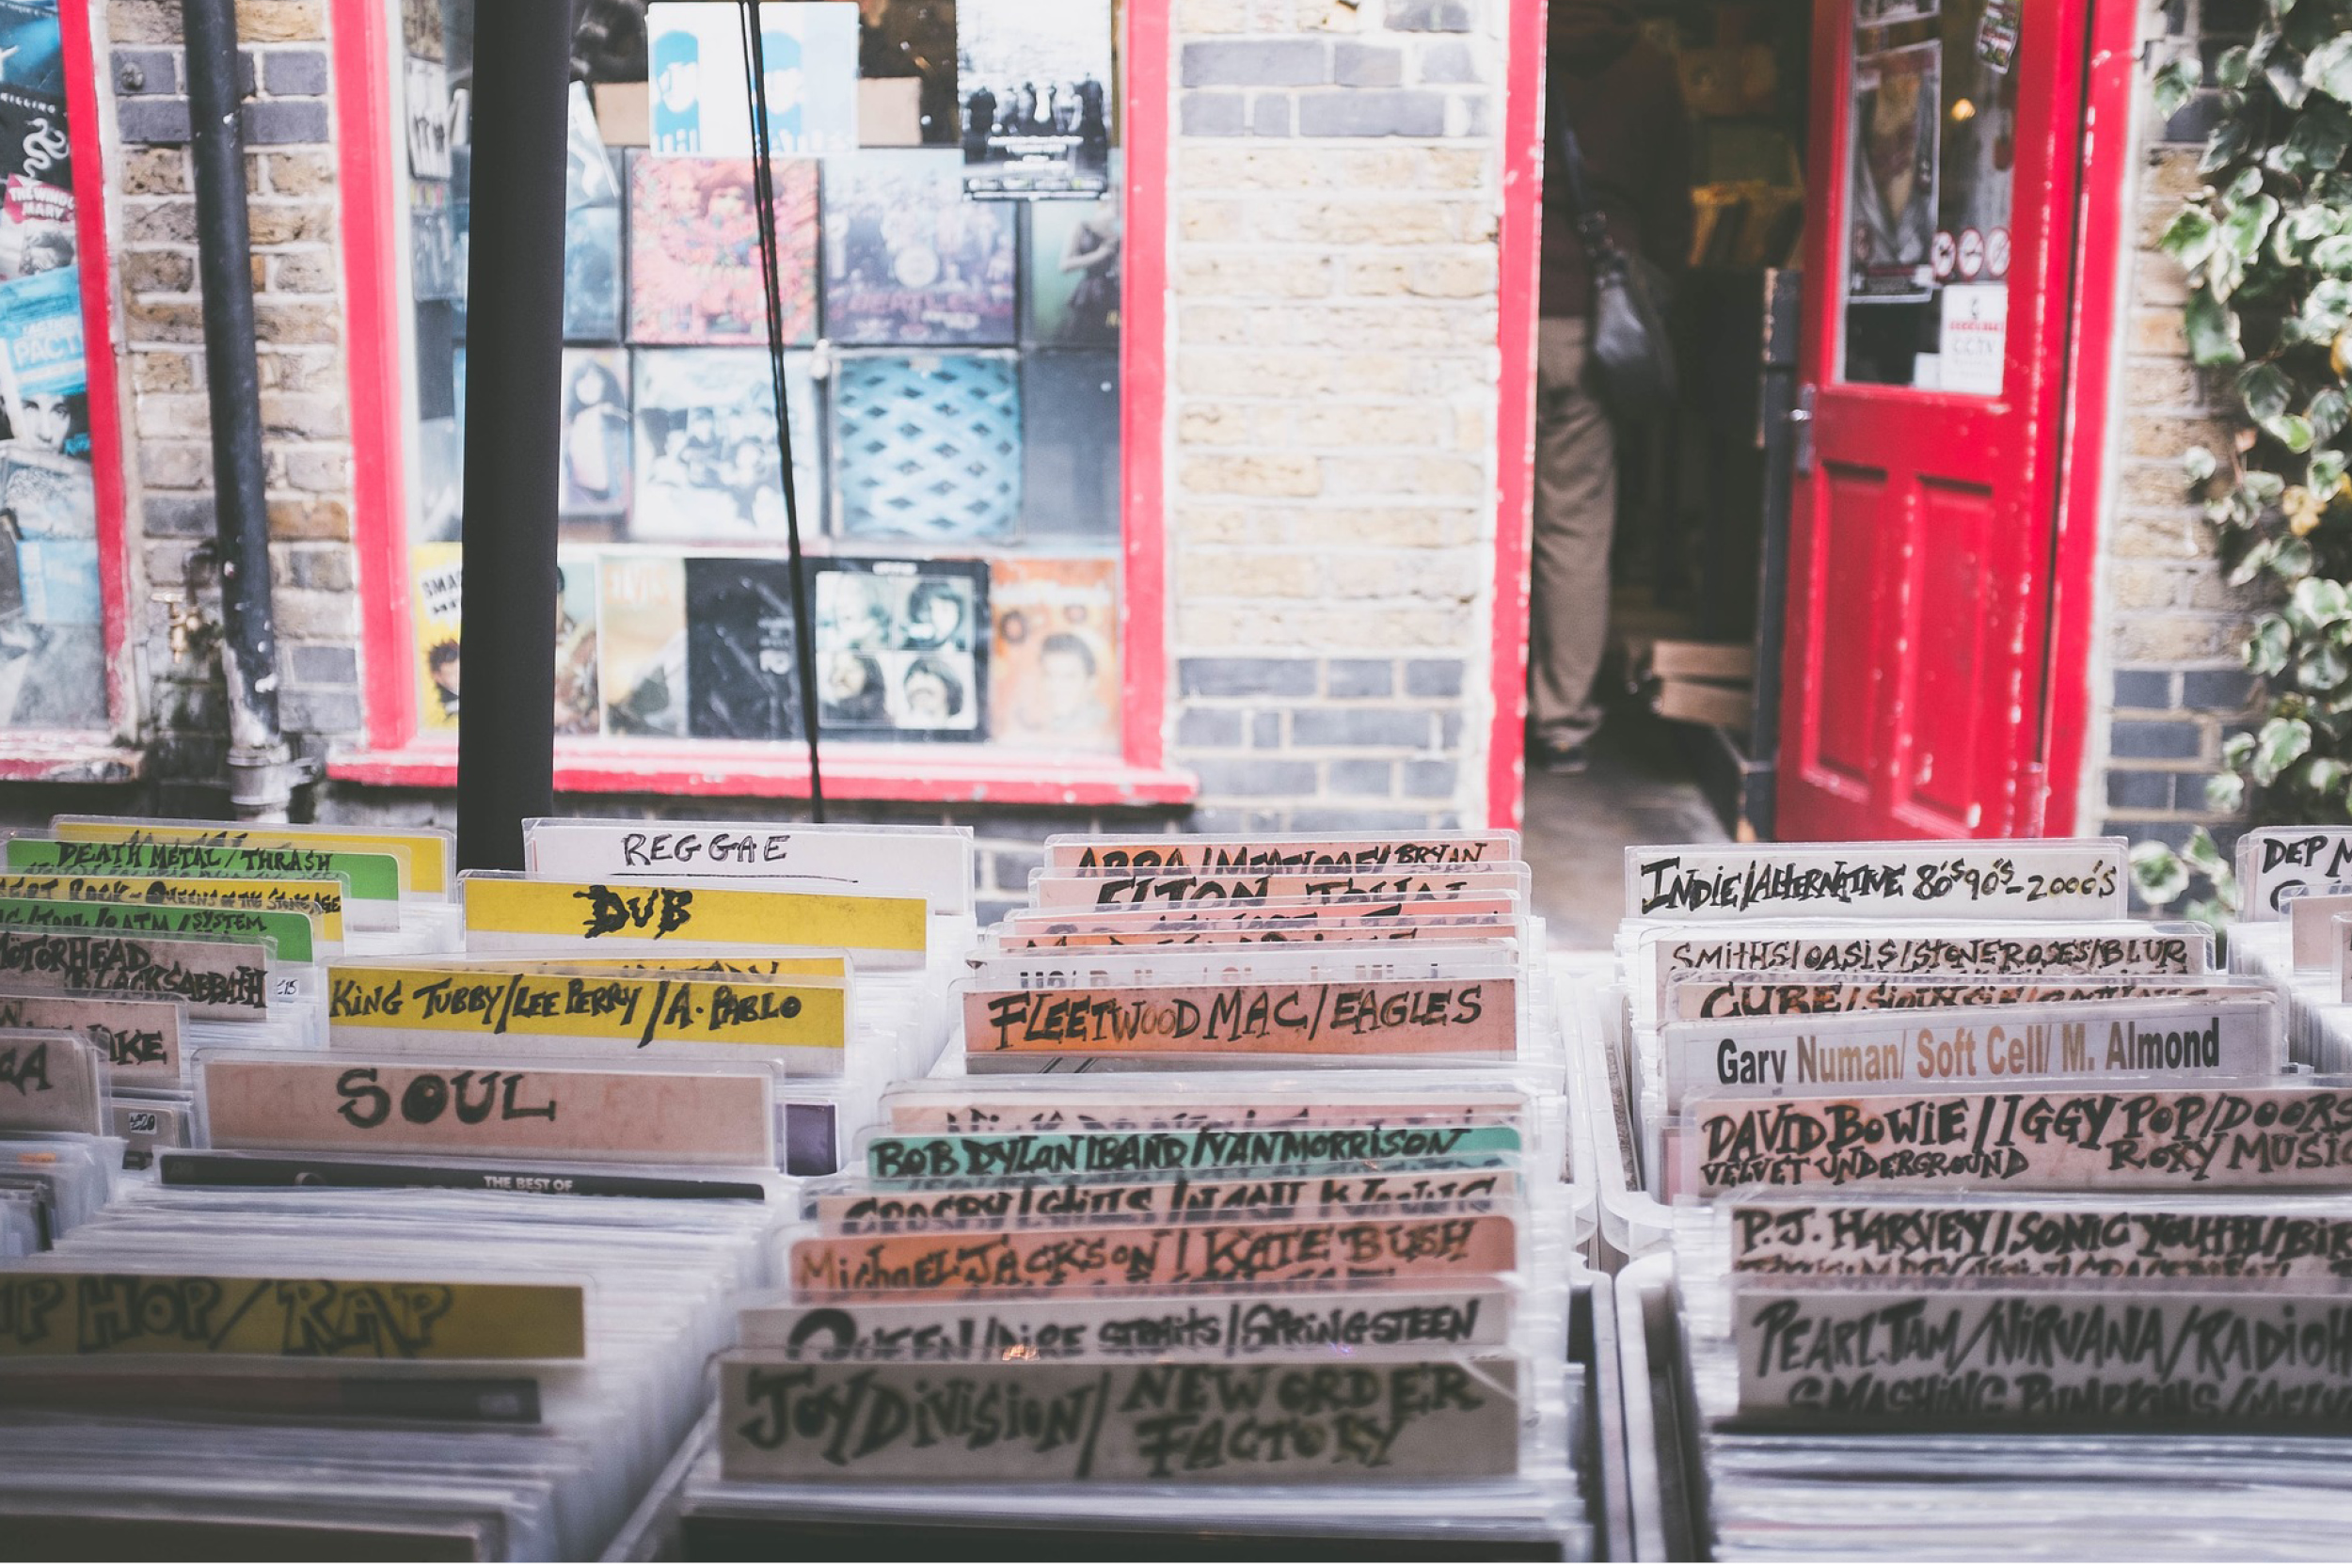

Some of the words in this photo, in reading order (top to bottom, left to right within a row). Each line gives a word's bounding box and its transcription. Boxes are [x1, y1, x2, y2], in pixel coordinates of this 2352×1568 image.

[55, 841, 144, 868] DEATH
[621, 833, 792, 866] REGGAE
[2263, 835, 2328, 874] DEP
[573, 885, 693, 940] DUB
[329, 976, 403, 1018] KING
[707, 985, 803, 1031] PABLO
[988, 990, 1200, 1051] FLEETWOOD
[1915, 1025, 1978, 1078] Soft
[2060, 1022, 2096, 1071] M.
[2105, 1017, 2220, 1069] Almond
[338, 1069, 556, 1129] SOUL
[868, 1136, 961, 1177] BOB
[1701, 1103, 1828, 1163] DAVID
[1701, 1152, 1810, 1186] VELVET
[1815, 1145, 2029, 1186] UNDERGROUND
[2106, 1132, 2229, 1181] ROXY
[484, 1176, 512, 1190] THE
[516, 1177, 550, 1191] BEST
[552, 1179, 573, 1192] OF
[1338, 1220, 1476, 1262] BUSH
[1751, 1299, 1878, 1379] PEARL
[737, 1367, 880, 1466] JOY
[1120, 1363, 1274, 1412] NEW
[1277, 1362, 1486, 1417] ORDER
[1135, 1413, 1407, 1479] FACTORY
